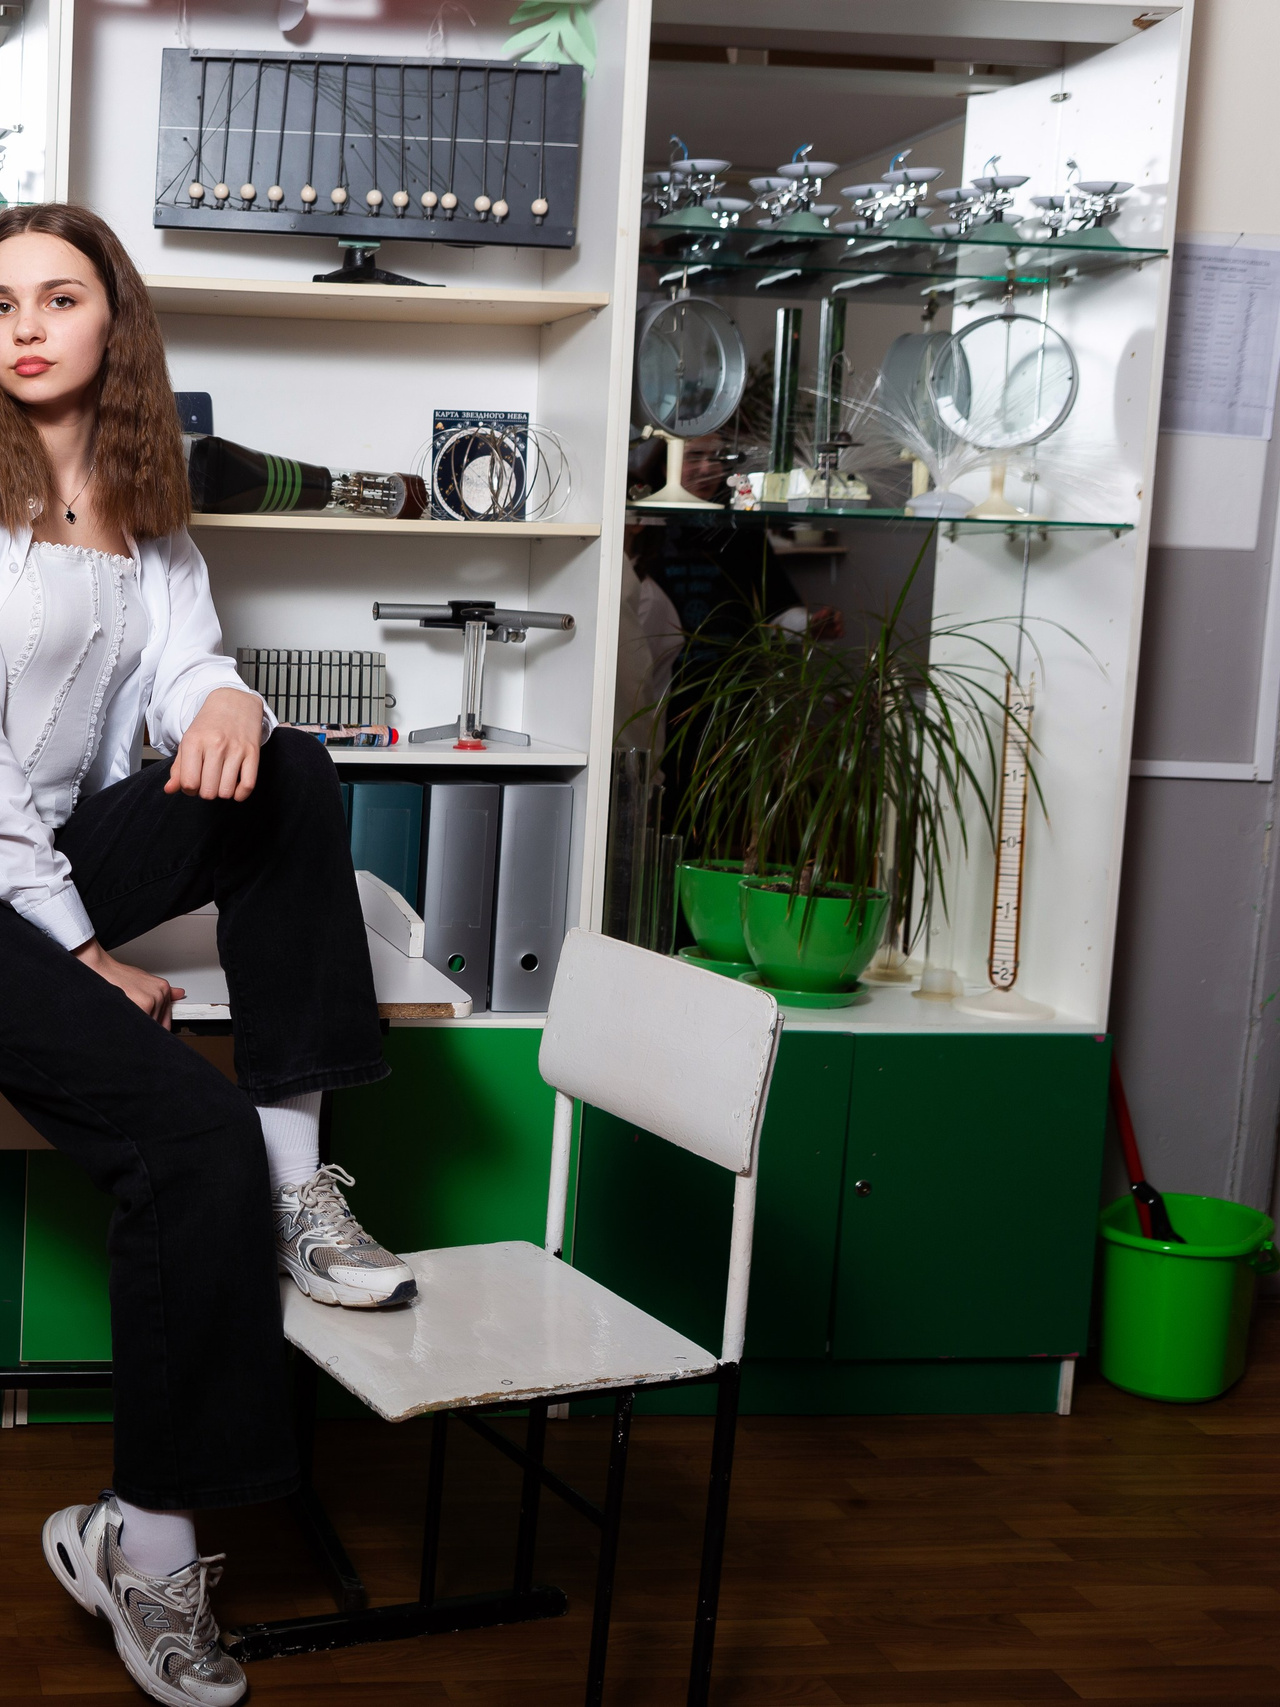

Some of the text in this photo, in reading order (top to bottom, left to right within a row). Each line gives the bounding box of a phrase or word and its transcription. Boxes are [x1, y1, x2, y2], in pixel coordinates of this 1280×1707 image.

[462, 412, 504, 420] ЗВЕЗДНОГО
[1013, 702, 1024, 715] 2
[1006, 836, 1017, 849] 0
[999, 967, 1009, 980] 2
[275, 1213, 303, 1243] N
[137, 1602, 170, 1627] N
